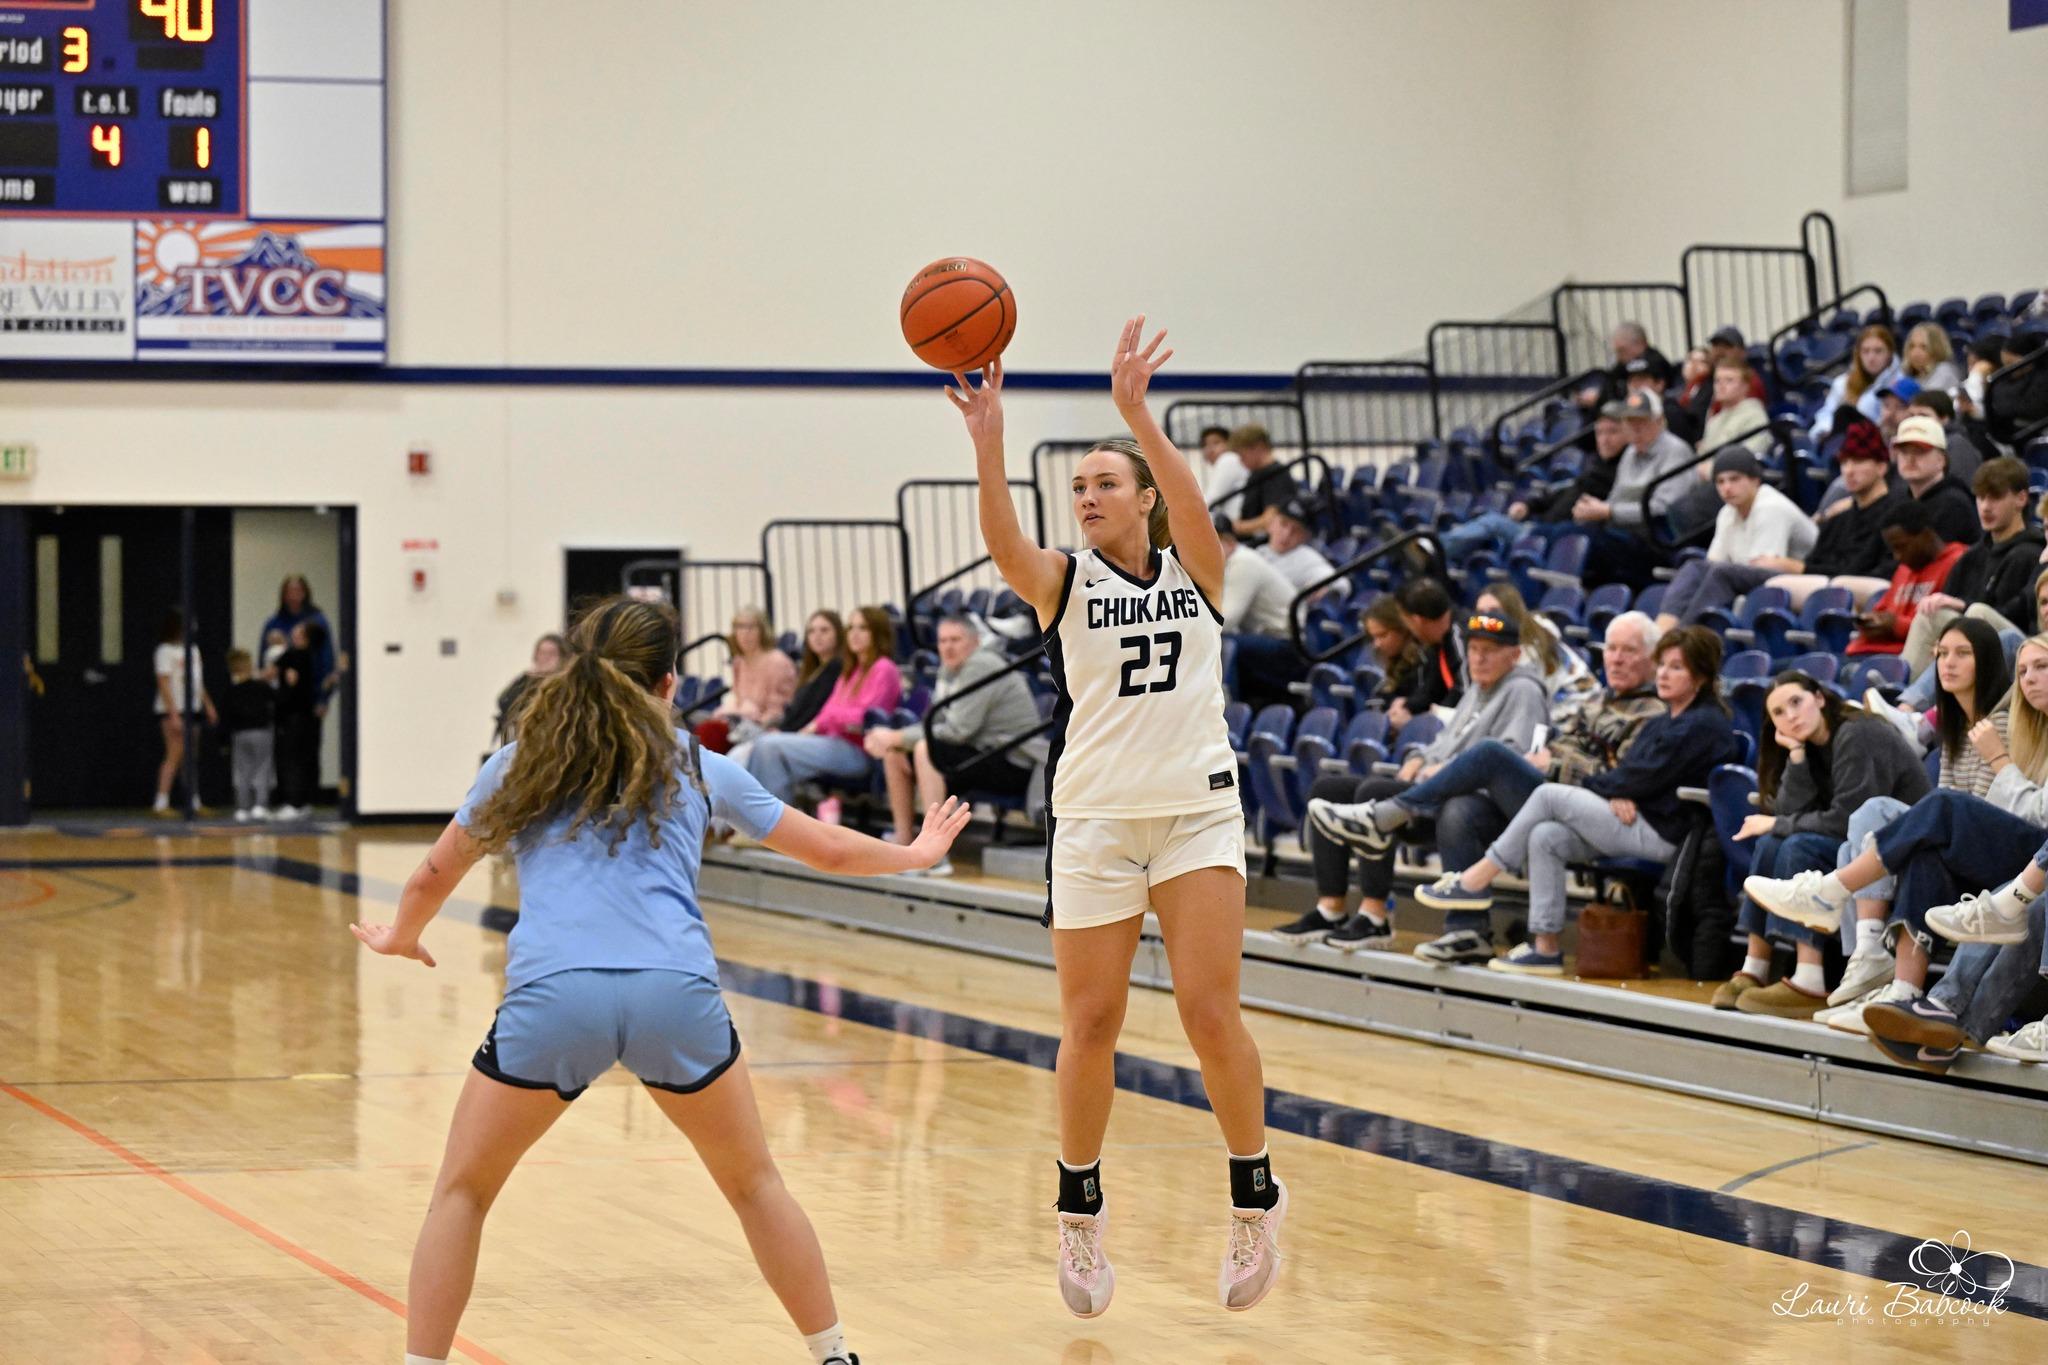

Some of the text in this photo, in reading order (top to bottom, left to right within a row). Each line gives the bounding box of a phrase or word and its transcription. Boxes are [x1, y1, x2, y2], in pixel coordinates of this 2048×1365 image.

[63, 27, 88, 72] 3
[0, 88, 43, 115] yer
[163, 89, 216, 117] fouls
[92, 125, 120, 166] 4
[197, 127, 209, 168] 1
[168, 181, 213, 203] won
[177, 265, 348, 316] TVCC
[1087, 588, 1199, 630] CHUKARS
[1118, 631, 1182, 697] 23
